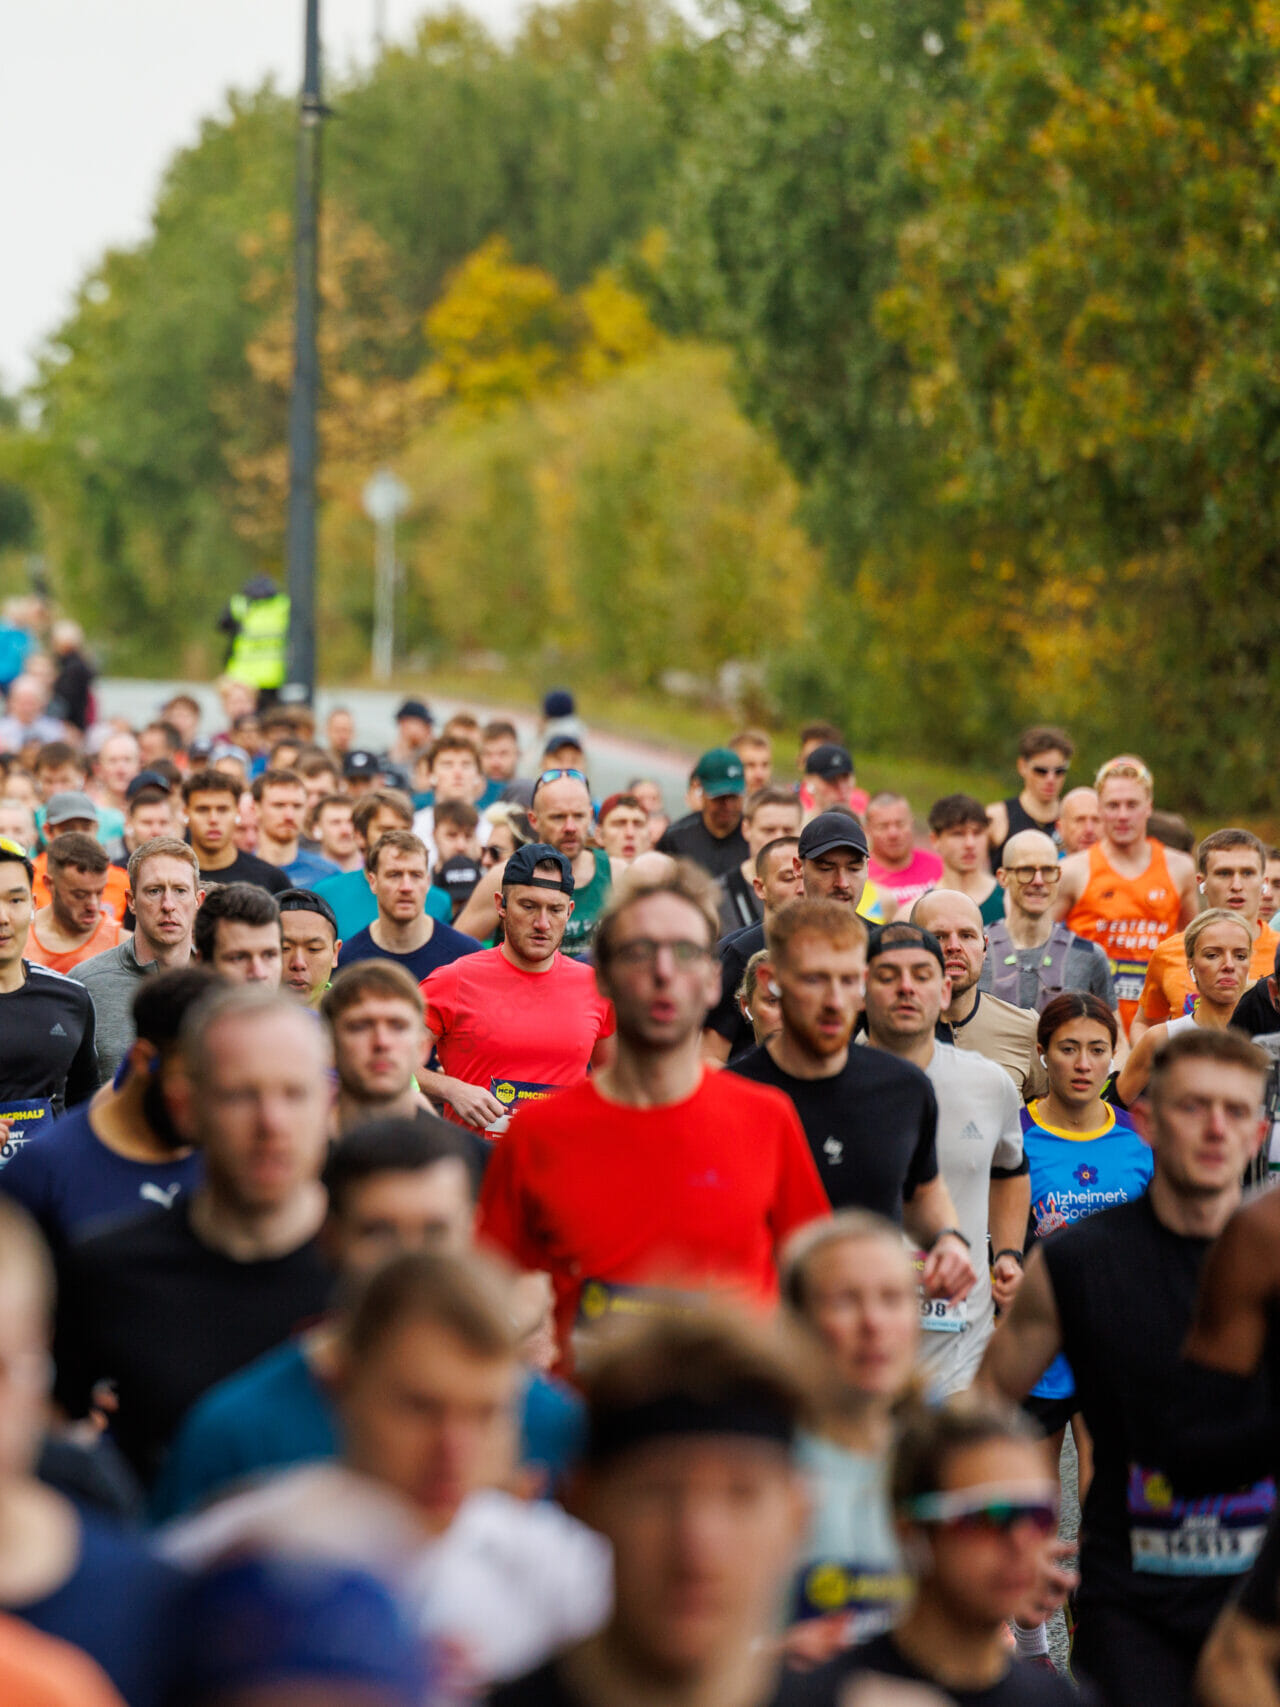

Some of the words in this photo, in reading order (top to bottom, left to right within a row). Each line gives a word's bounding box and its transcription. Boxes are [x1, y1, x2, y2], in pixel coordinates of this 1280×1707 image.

[1096, 919, 1169, 935] WESTERN
[1108, 935, 1158, 950] TEMPO
[1046, 1188, 1128, 1206] Alzheimer's
